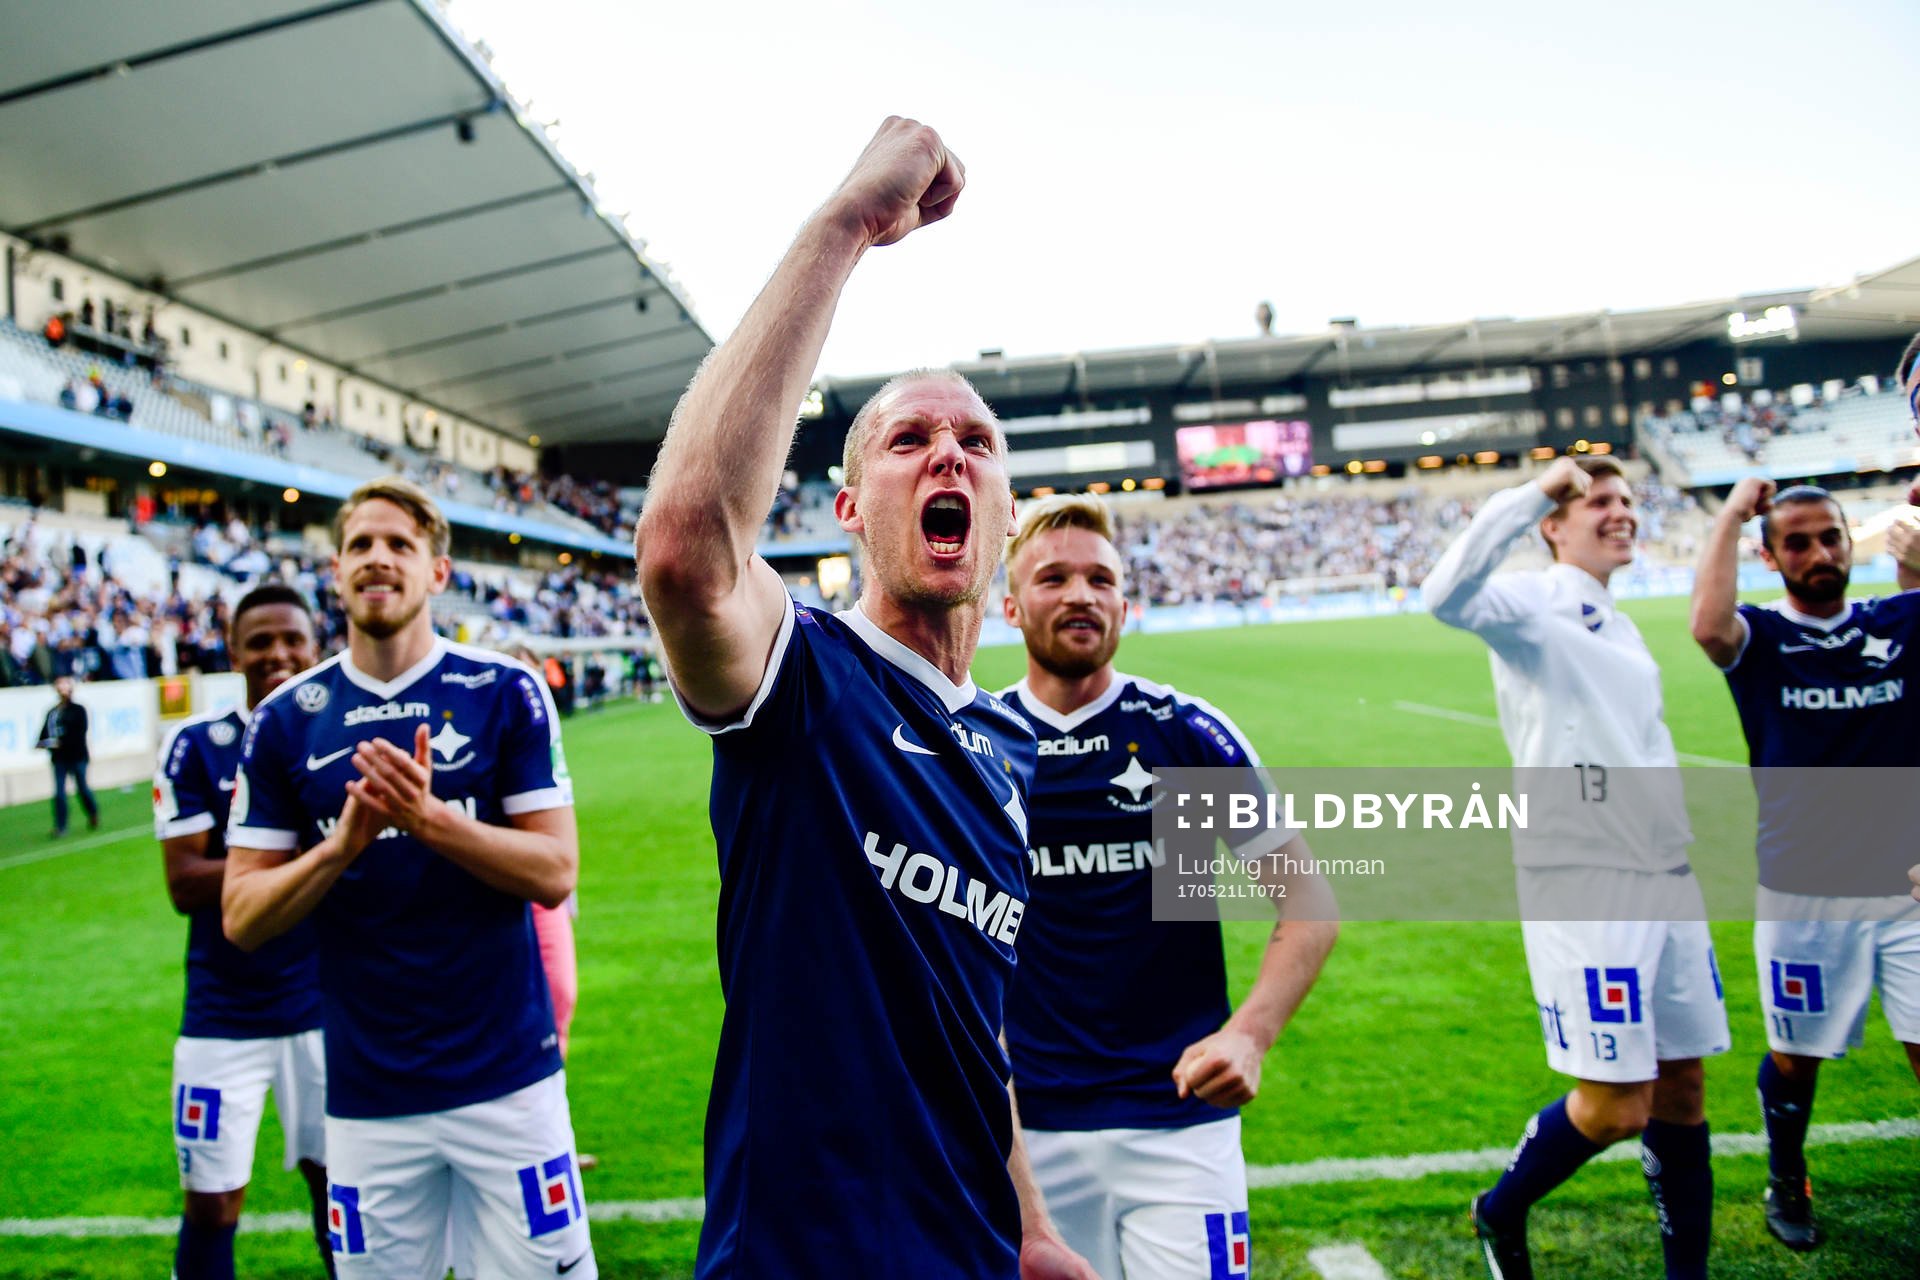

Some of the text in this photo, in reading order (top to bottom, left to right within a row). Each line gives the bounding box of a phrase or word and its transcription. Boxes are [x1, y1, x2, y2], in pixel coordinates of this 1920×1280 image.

[1782, 679, 1904, 709] HOLMEN
[343, 701, 430, 725] stadium
[950, 722, 994, 757] dium
[1037, 734, 1109, 756] adium
[1573, 764, 1608, 803] 13
[1031, 838, 1166, 876] LMEN
[863, 831, 1026, 946] HOLME
[1591, 1032, 1617, 1061] 13
